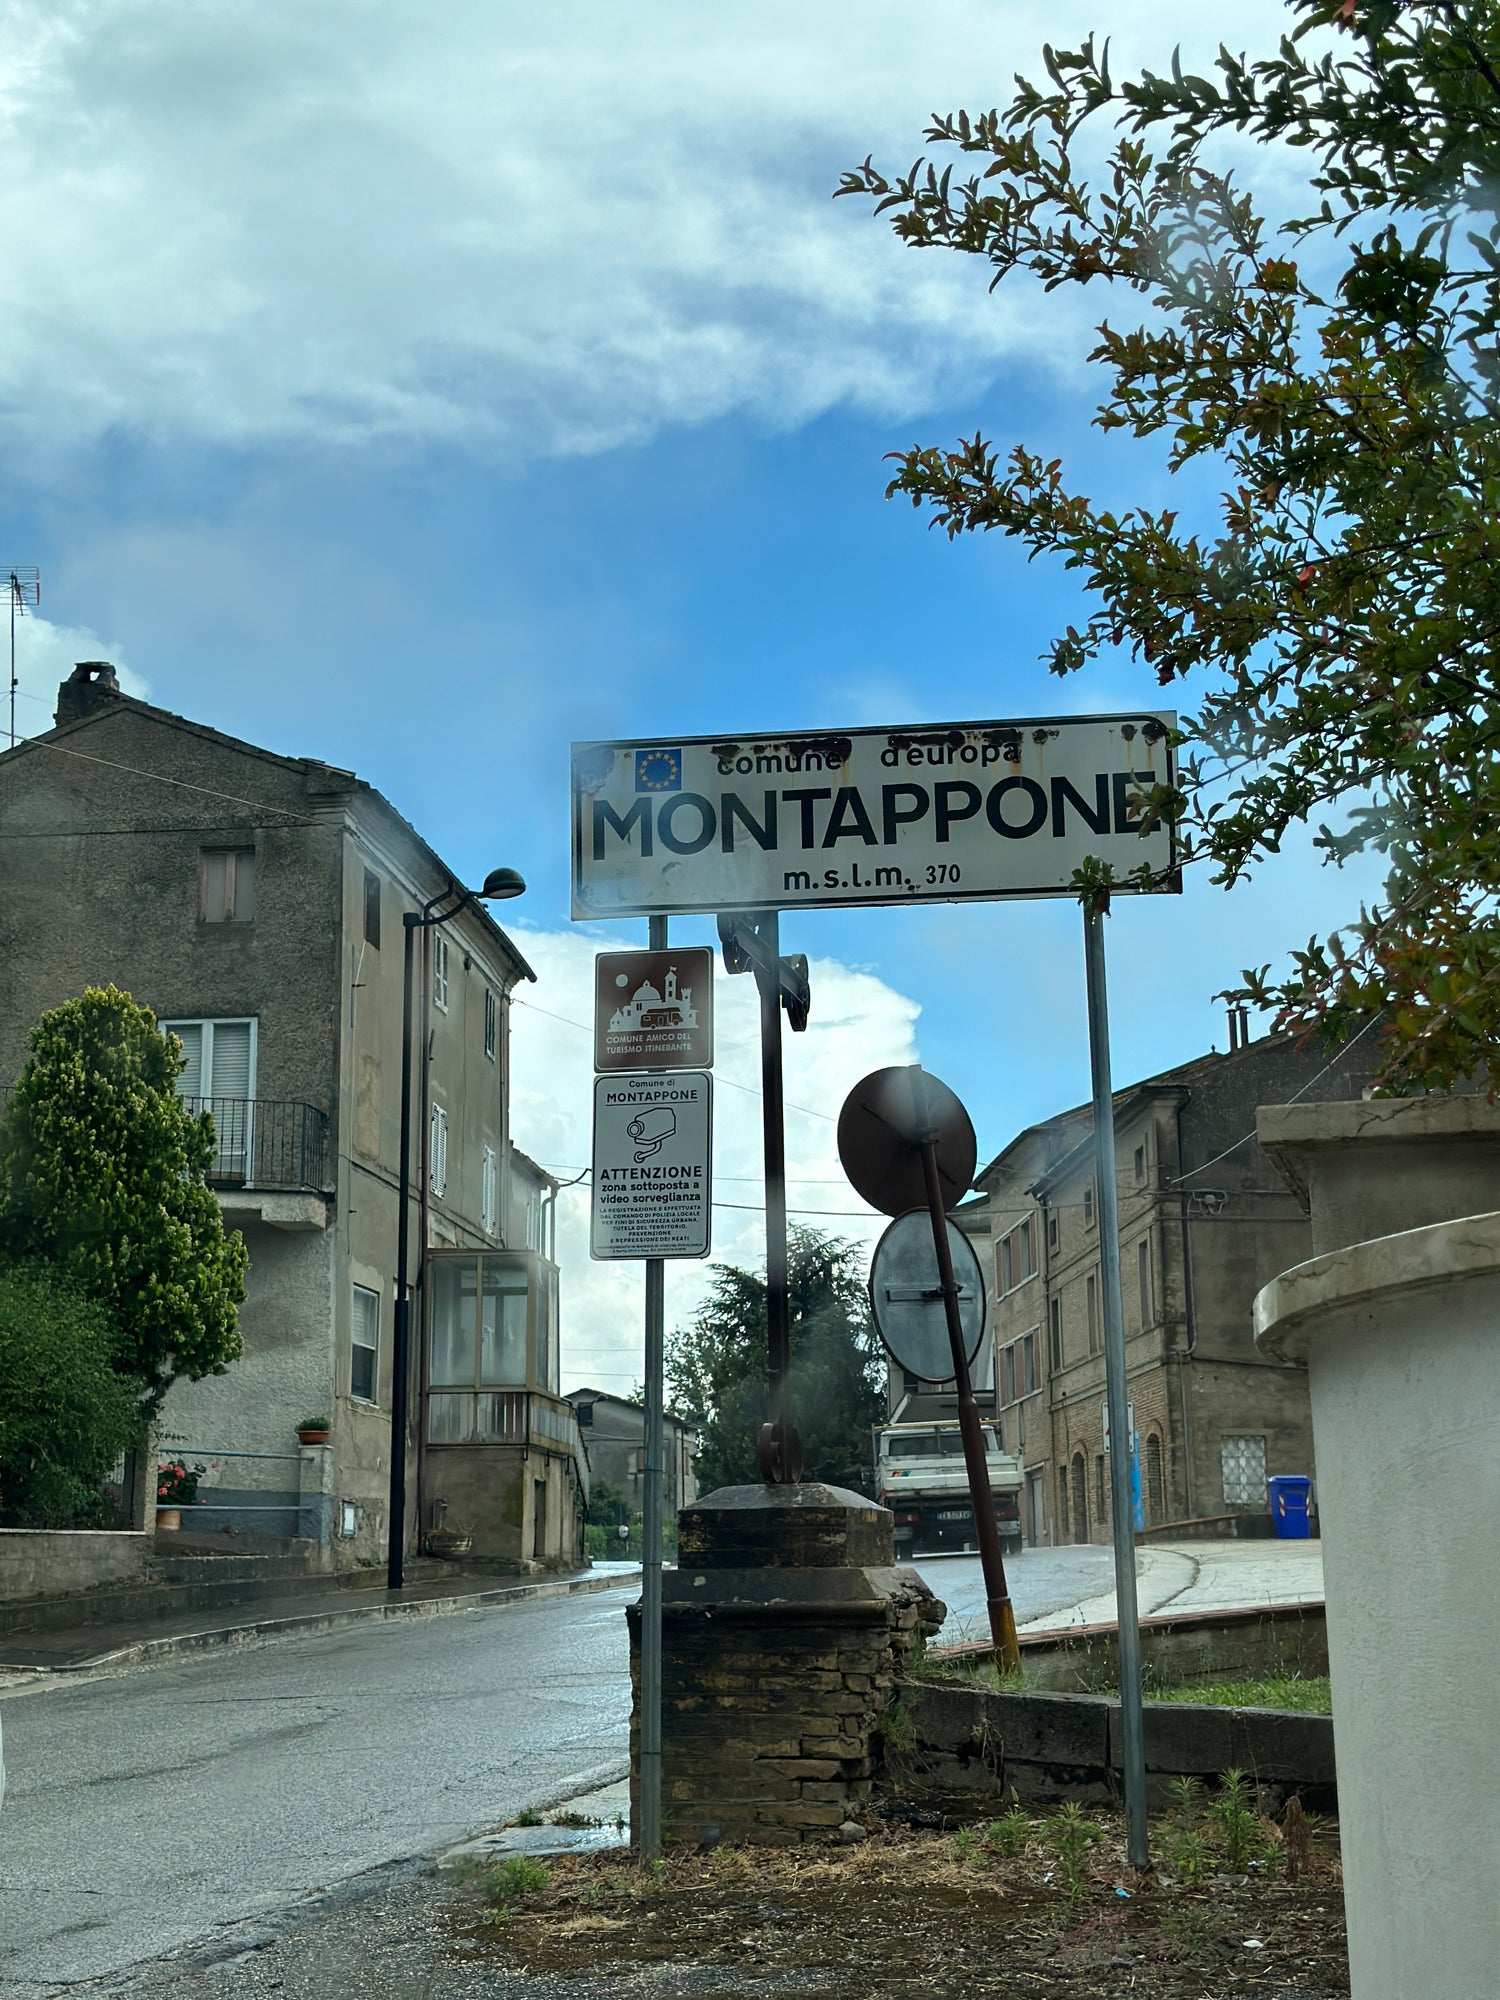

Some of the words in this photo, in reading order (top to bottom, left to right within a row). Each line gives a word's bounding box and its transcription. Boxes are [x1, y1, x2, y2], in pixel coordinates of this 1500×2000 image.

[717, 752, 842, 776] comune
[880, 738, 1020, 767] deuropa
[593, 771, 1162, 861] MONTAPPONE
[784, 863, 912, 891] m.s.l.m.
[925, 863, 961, 885] 370
[606, 1034, 643, 1044] COMUNE
[646, 1033, 675, 1042] AMICO
[677, 1032, 692, 1040] DEL
[606, 1045, 643, 1054] TURISMO
[645, 1042, 692, 1052] ITINERANTE
[629, 1080, 665, 1088] Comune
[607, 1089, 698, 1103] MONTAPPONE
[600, 1165, 703, 1180] ATTENZIONE
[602, 1183, 627, 1192] zona
[630, 1180, 690, 1192] sottoposta
[693, 1181, 700, 1189] a
[600, 1194, 629, 1204] video
[632, 1192, 700, 1204] sorveglianza
